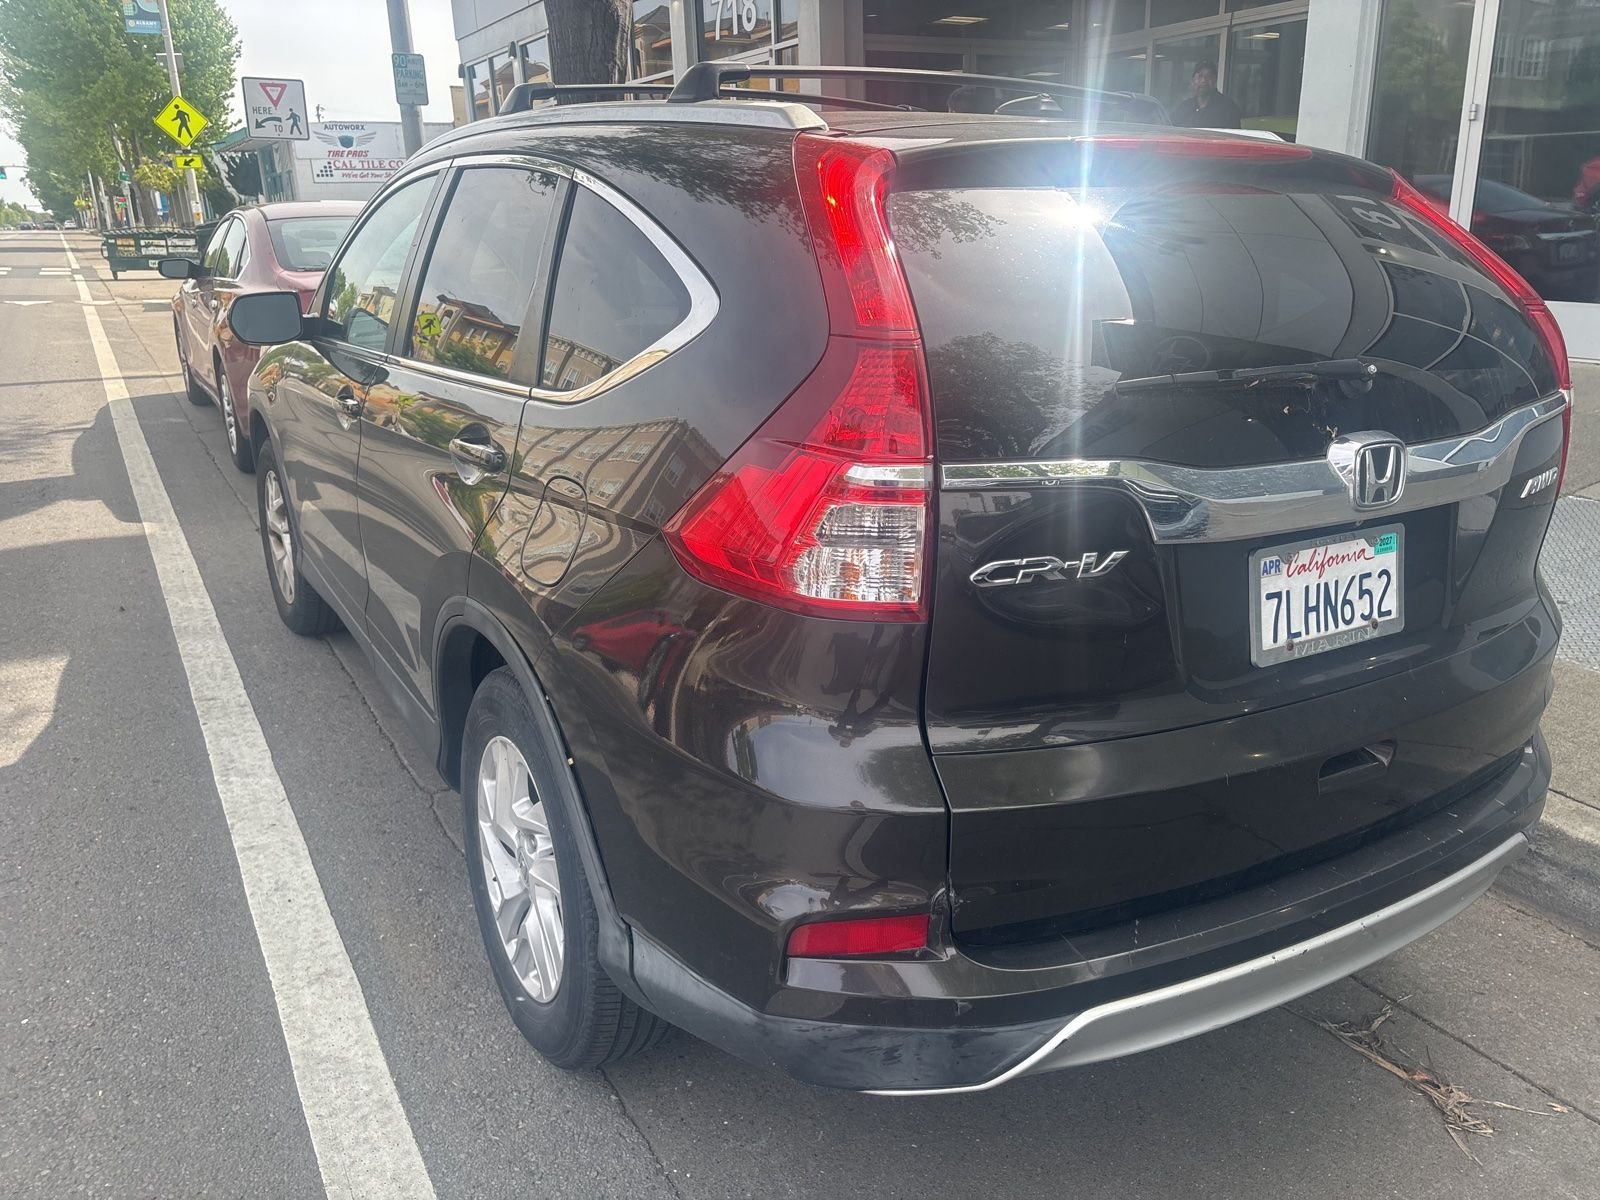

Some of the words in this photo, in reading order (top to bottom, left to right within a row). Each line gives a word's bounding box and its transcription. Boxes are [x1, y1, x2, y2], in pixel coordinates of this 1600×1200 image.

[711, 0, 757, 41] 718
[394, 55, 407, 67] 90
[396, 69, 424, 80] PARKING
[252, 106, 273, 115] HERE
[274, 124, 284, 133] TO
[323, 123, 366, 131] AUTOWORX
[327, 150, 346, 158] TIRE
[346, 150, 369, 158] PROS
[333, 160, 357, 169] CAL
[358, 160, 386, 169] TILE
[359, 171, 370, 179] Got
[1520, 466, 1559, 499] AWD
[1378, 536, 1393, 547] 2027
[1261, 558, 1282, 576] APR
[1286, 546, 1375, 579] California
[969, 550, 1130, 588] CR-V
[1265, 568, 1392, 644] 7LHN652
[1294, 627, 1371, 657] MARIN
